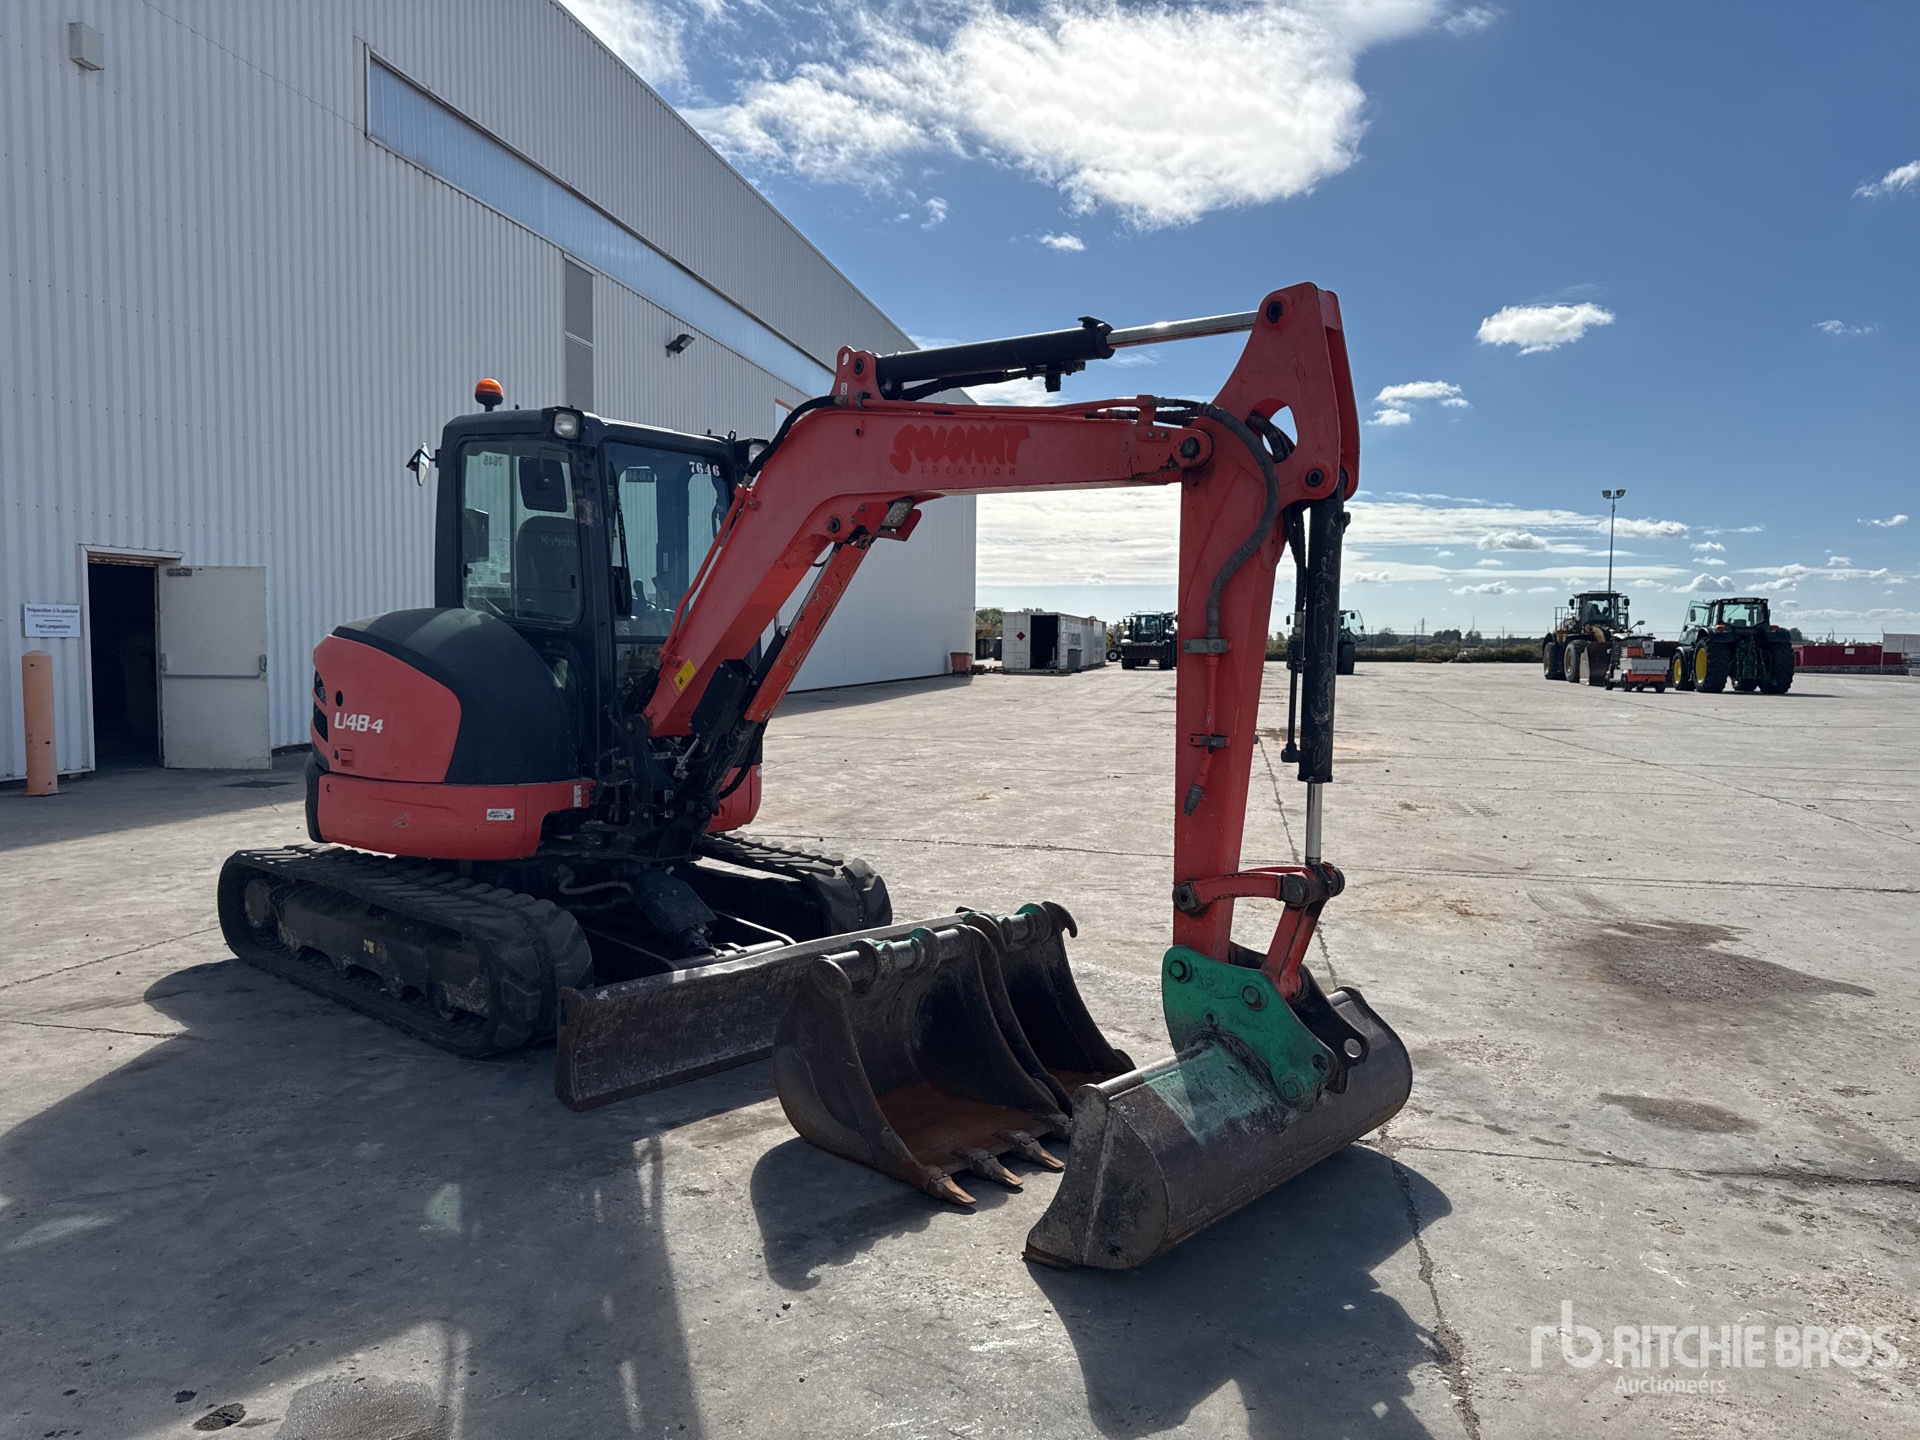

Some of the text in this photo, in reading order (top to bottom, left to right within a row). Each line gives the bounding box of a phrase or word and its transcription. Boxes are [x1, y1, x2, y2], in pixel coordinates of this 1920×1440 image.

[688, 461, 720, 477] 7646
[920, 465, 1016, 477] LOCATION
[334, 712, 384, 734] U48-4
